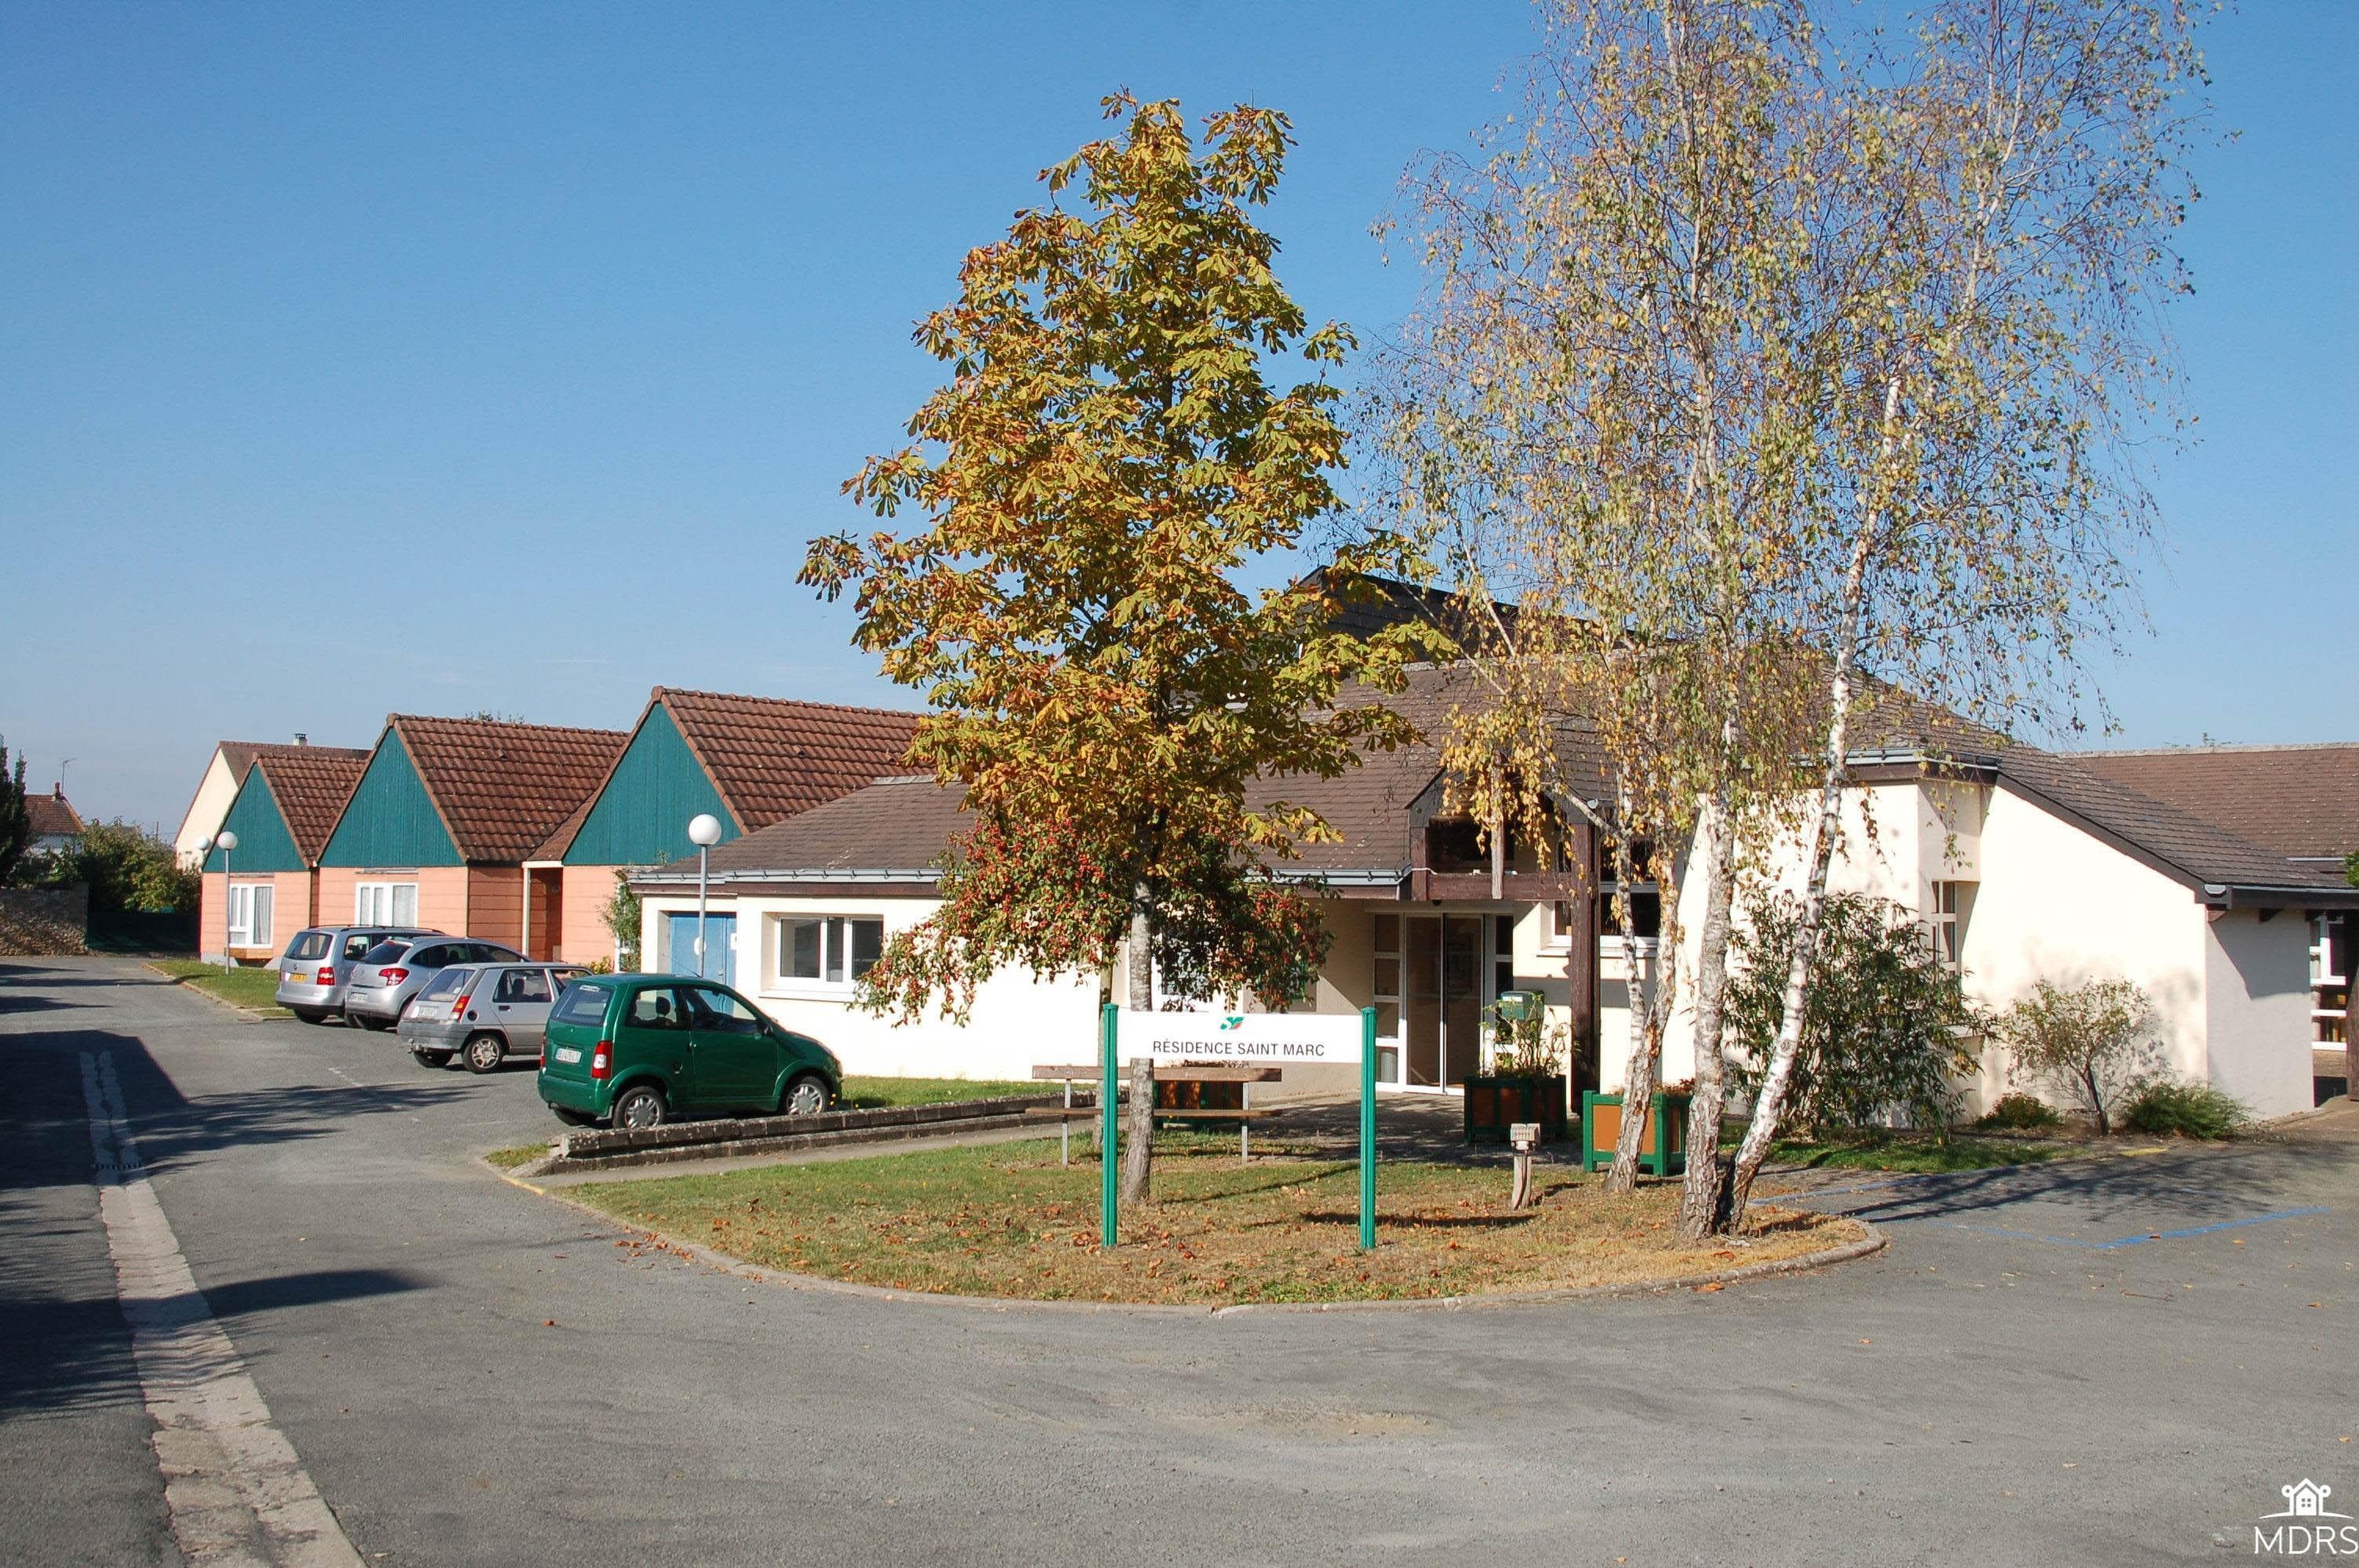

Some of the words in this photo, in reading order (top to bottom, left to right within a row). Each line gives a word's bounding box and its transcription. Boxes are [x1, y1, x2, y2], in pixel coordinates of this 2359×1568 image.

[1153, 1038, 1233, 1054] RÉSIDENCE
[1238, 1043, 1278, 1055] SAINT
[1283, 1044, 1325, 1057] MARC
